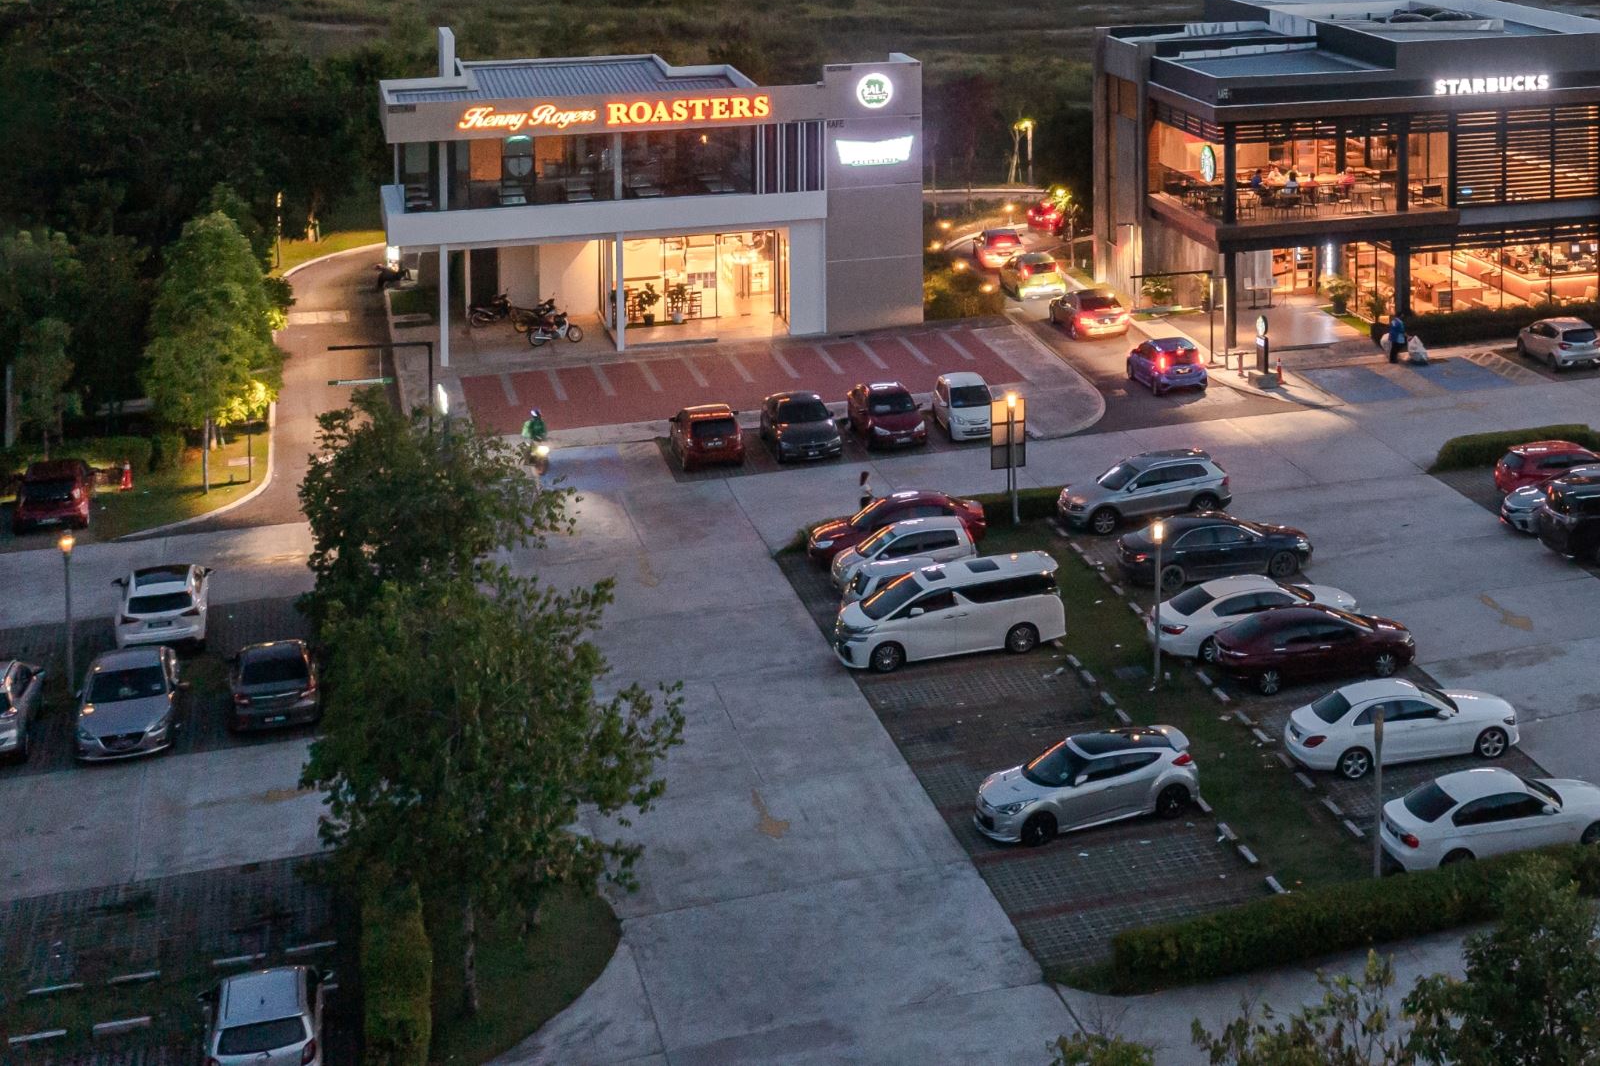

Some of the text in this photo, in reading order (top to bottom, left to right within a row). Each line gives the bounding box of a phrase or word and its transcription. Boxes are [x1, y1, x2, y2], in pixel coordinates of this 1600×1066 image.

[1434, 74, 1549, 94] STARBUCKS
[458, 95, 771, 131] Kenny Rogers ROASTERS
